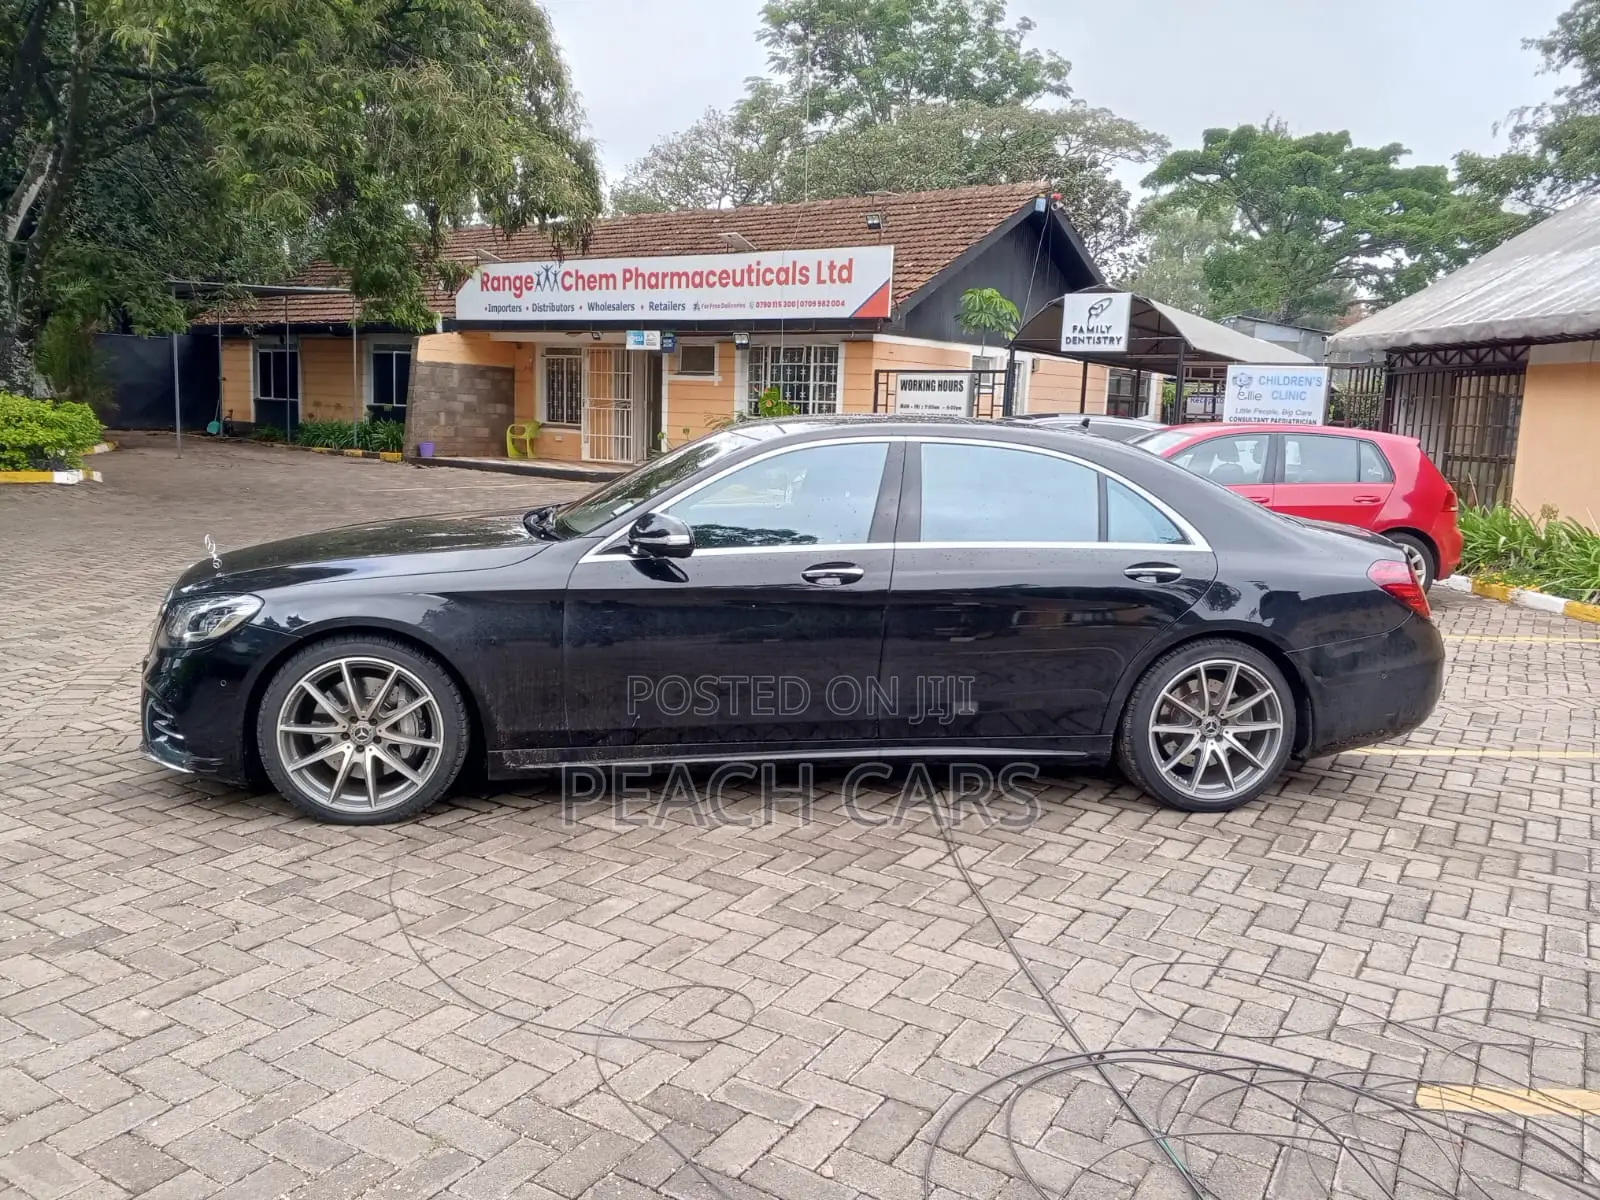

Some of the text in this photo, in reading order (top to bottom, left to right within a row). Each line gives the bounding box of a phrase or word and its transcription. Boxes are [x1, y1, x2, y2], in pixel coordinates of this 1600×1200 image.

[480, 257, 854, 299] Range Chem Pharmaceuticals Ltd
[487, 300, 686, 314] Importers Distributors Wholesalers Retailers
[1072, 324, 1112, 334] FAMILY
[1065, 336, 1122, 345] DENTISTRY
[900, 379, 964, 392] WORKING HOURS
[1258, 375, 1323, 387] CHILDREN'S
[1271, 390, 1307, 401] CLINIC
[1281, 408, 1294, 417] Big
[1295, 408, 1312, 416] Care
[1270, 417, 1317, 425] PAEDIATRICIAN
